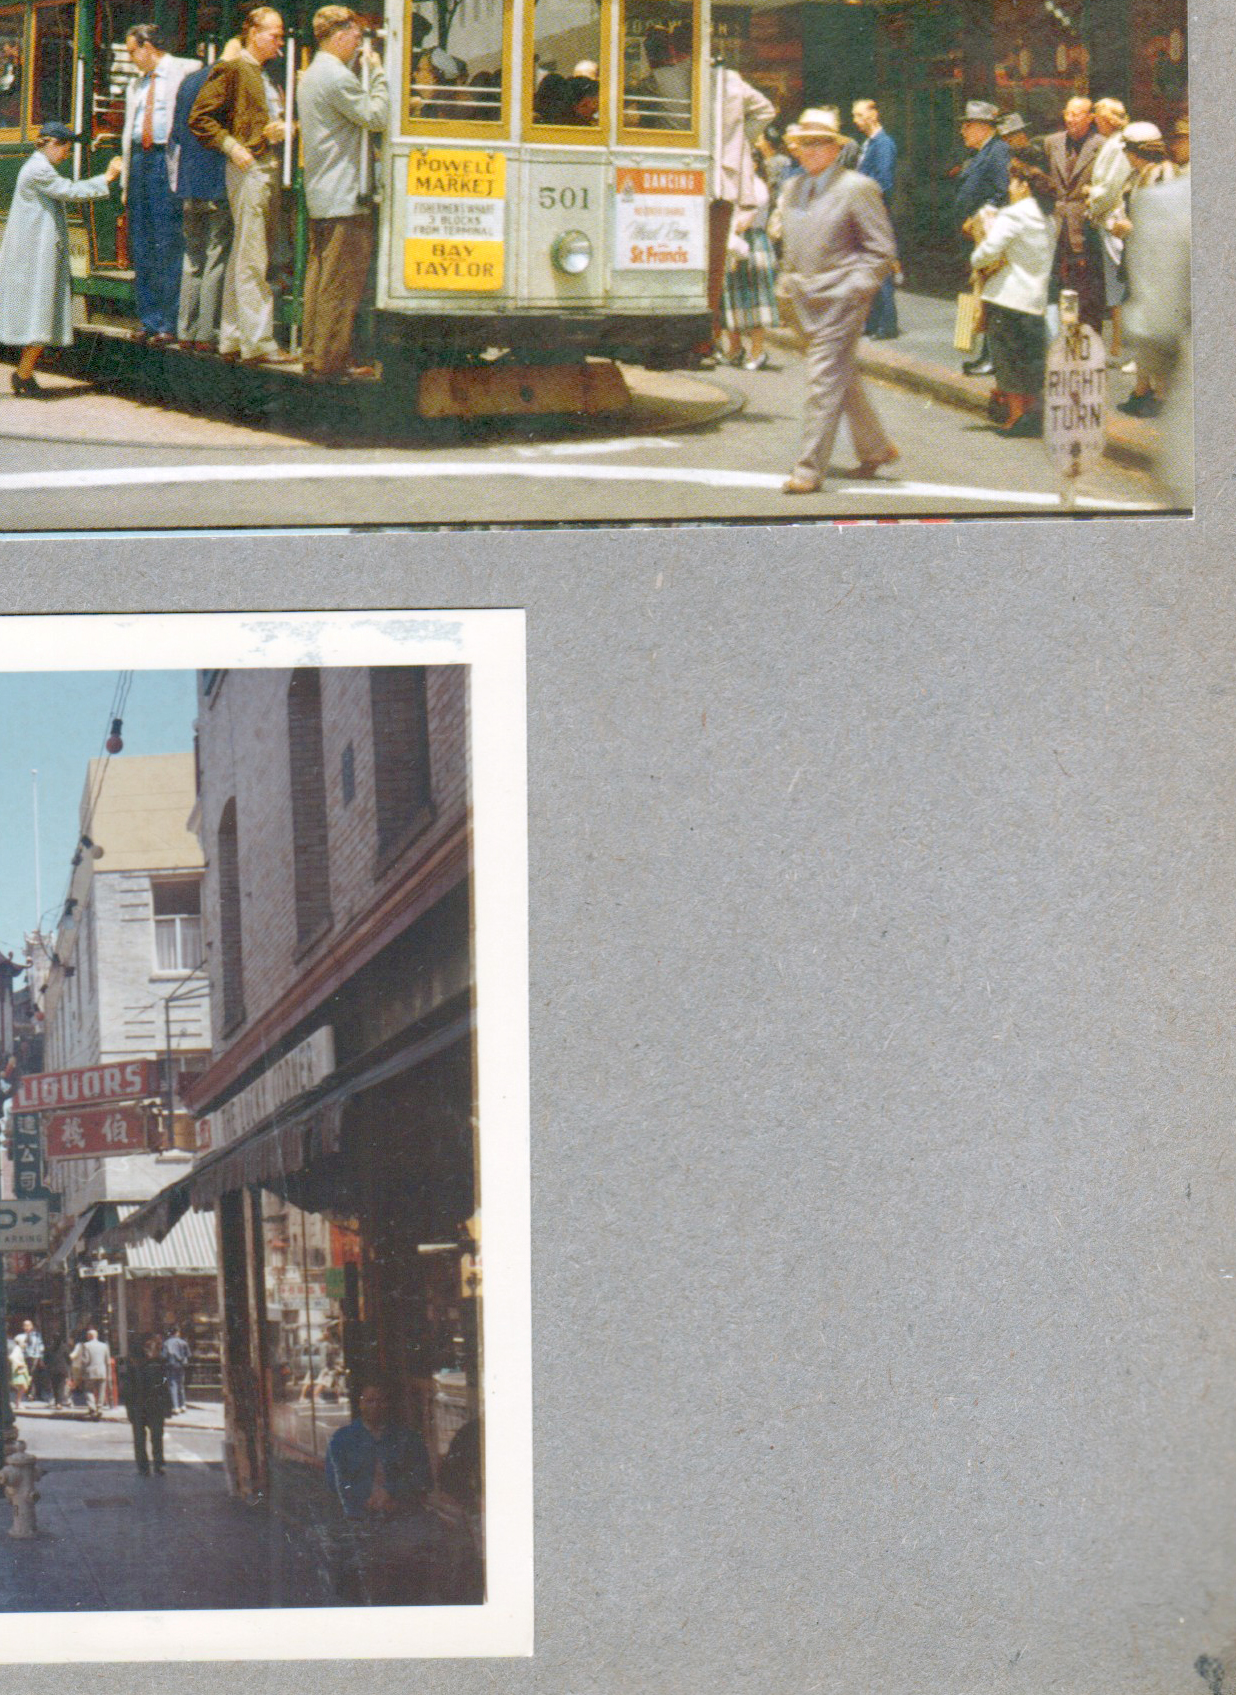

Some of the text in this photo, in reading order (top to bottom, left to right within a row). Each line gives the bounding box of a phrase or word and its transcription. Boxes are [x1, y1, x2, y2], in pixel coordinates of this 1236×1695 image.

[416, 159, 496, 174] POWELL
[416, 176, 494, 196] MARKET
[642, 172, 696, 189] DANCING
[539, 186, 590, 210] 501
[432, 243, 475, 257] BAY
[646, 245, 689, 264] Francis
[414, 261, 495, 277] TAYLOR
[1066, 335, 1090, 361] NO
[1048, 368, 1106, 395] RIGHT
[1051, 404, 1102, 431] TURN
[17, 1061, 142, 1106] LIQUORS
